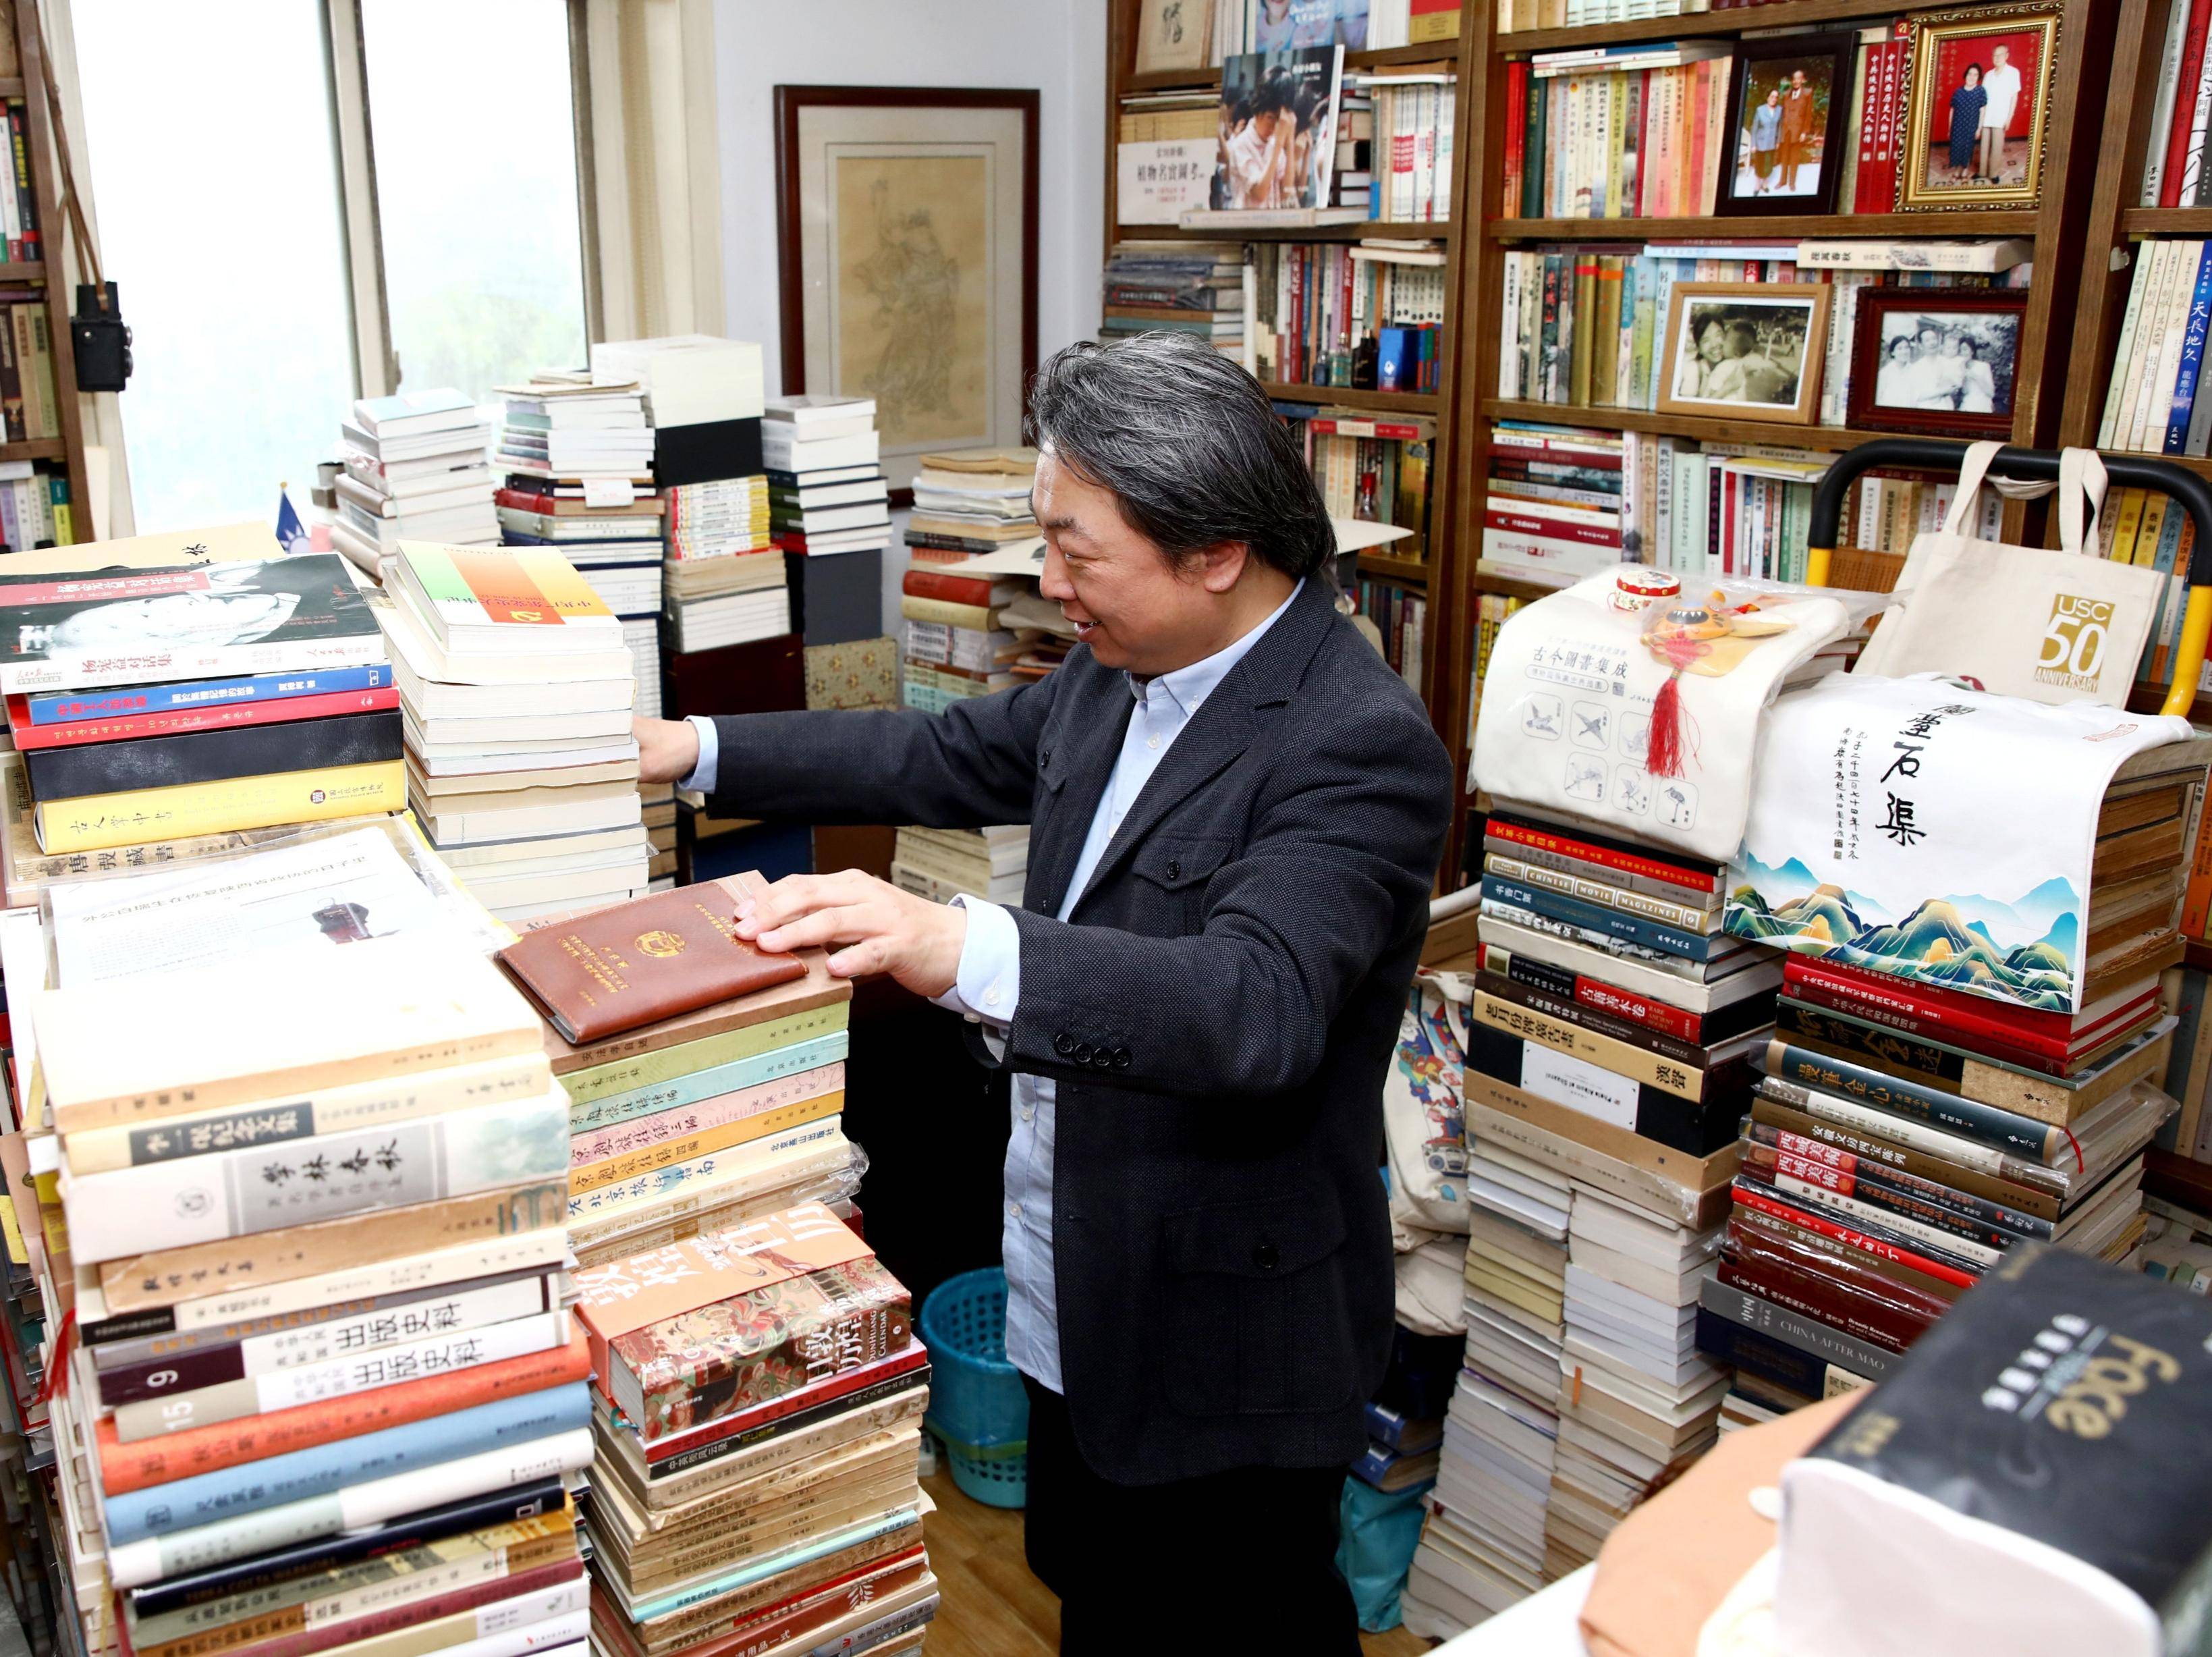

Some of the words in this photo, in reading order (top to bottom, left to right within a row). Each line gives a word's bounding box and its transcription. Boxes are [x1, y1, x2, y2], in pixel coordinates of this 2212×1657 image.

[2196, 99, 2209, 117] 阿城
[2184, 300, 2209, 362] 天長地久
[57, 574, 196, 594] 杨宪益对话集
[2057, 595, 2110, 622] USC
[82, 653, 172, 674] 杨宪益对话集
[1531, 646, 1630, 679] 古今圖書集成
[2037, 614, 2108, 680] 50
[2033, 667, 2100, 694] ANNIVERSARY
[69, 845, 174, 874] 唐弢藏書
[1529, 871, 1570, 890] CHINESE
[1579, 885, 1611, 901] MOVIE
[1621, 896, 1677, 919] MAGAZINES
[1580, 985, 1647, 1018] 古籍善本卷
[1655, 1063, 1687, 1090] 漢聲
[770, 1126, 835, 1153] 北京燕山出版社
[1777, 1131, 1839, 1169] 西域美術
[1811, 1126, 1908, 1167] 安徽文房四宝陈列
[260, 1137, 404, 1187] 學林春秋
[1777, 1151, 1838, 1191] 西域美術
[568, 1159, 715, 1217] 老北京旅行指南
[335, 1301, 462, 1351] 出版史料
[1779, 1319, 1817, 1344] CHINA
[1821, 1336, 1854, 1359] AFTER
[1857, 1351, 1885, 1370] MAO
[353, 1337, 484, 1386] 出版史料
[146, 1369, 179, 1388] 9
[161, 1401, 194, 1432] 15
